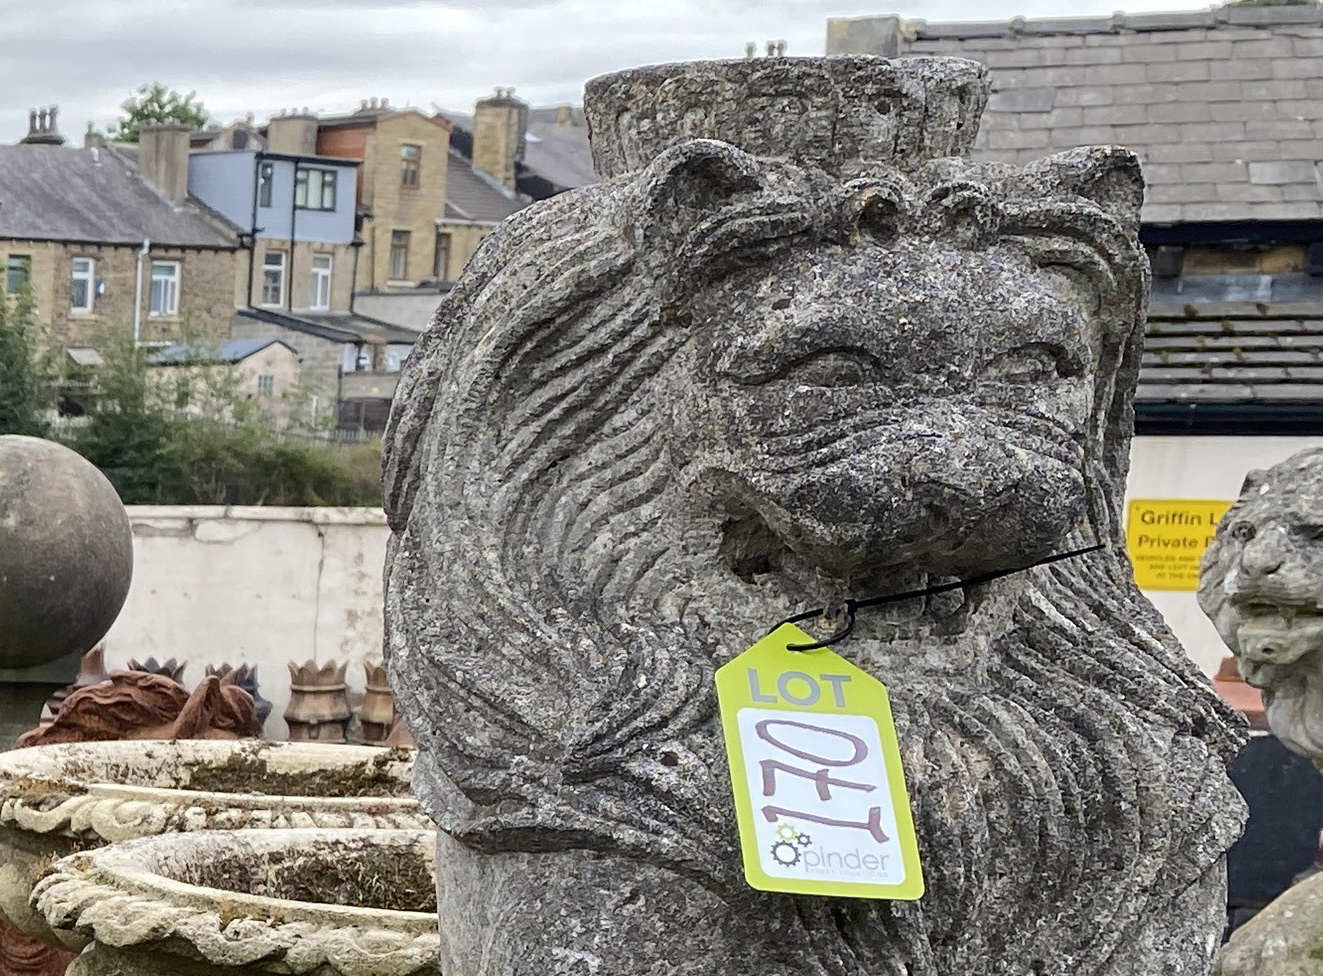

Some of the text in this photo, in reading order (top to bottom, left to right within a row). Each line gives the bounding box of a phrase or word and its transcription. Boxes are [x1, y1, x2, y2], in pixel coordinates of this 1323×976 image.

[1141, 510, 1202, 525] Griffin
[1138, 535, 1199, 548] Private
[747, 667, 852, 708] LOT
[755, 719, 890, 843] 170
[803, 845, 890, 873] pinder
